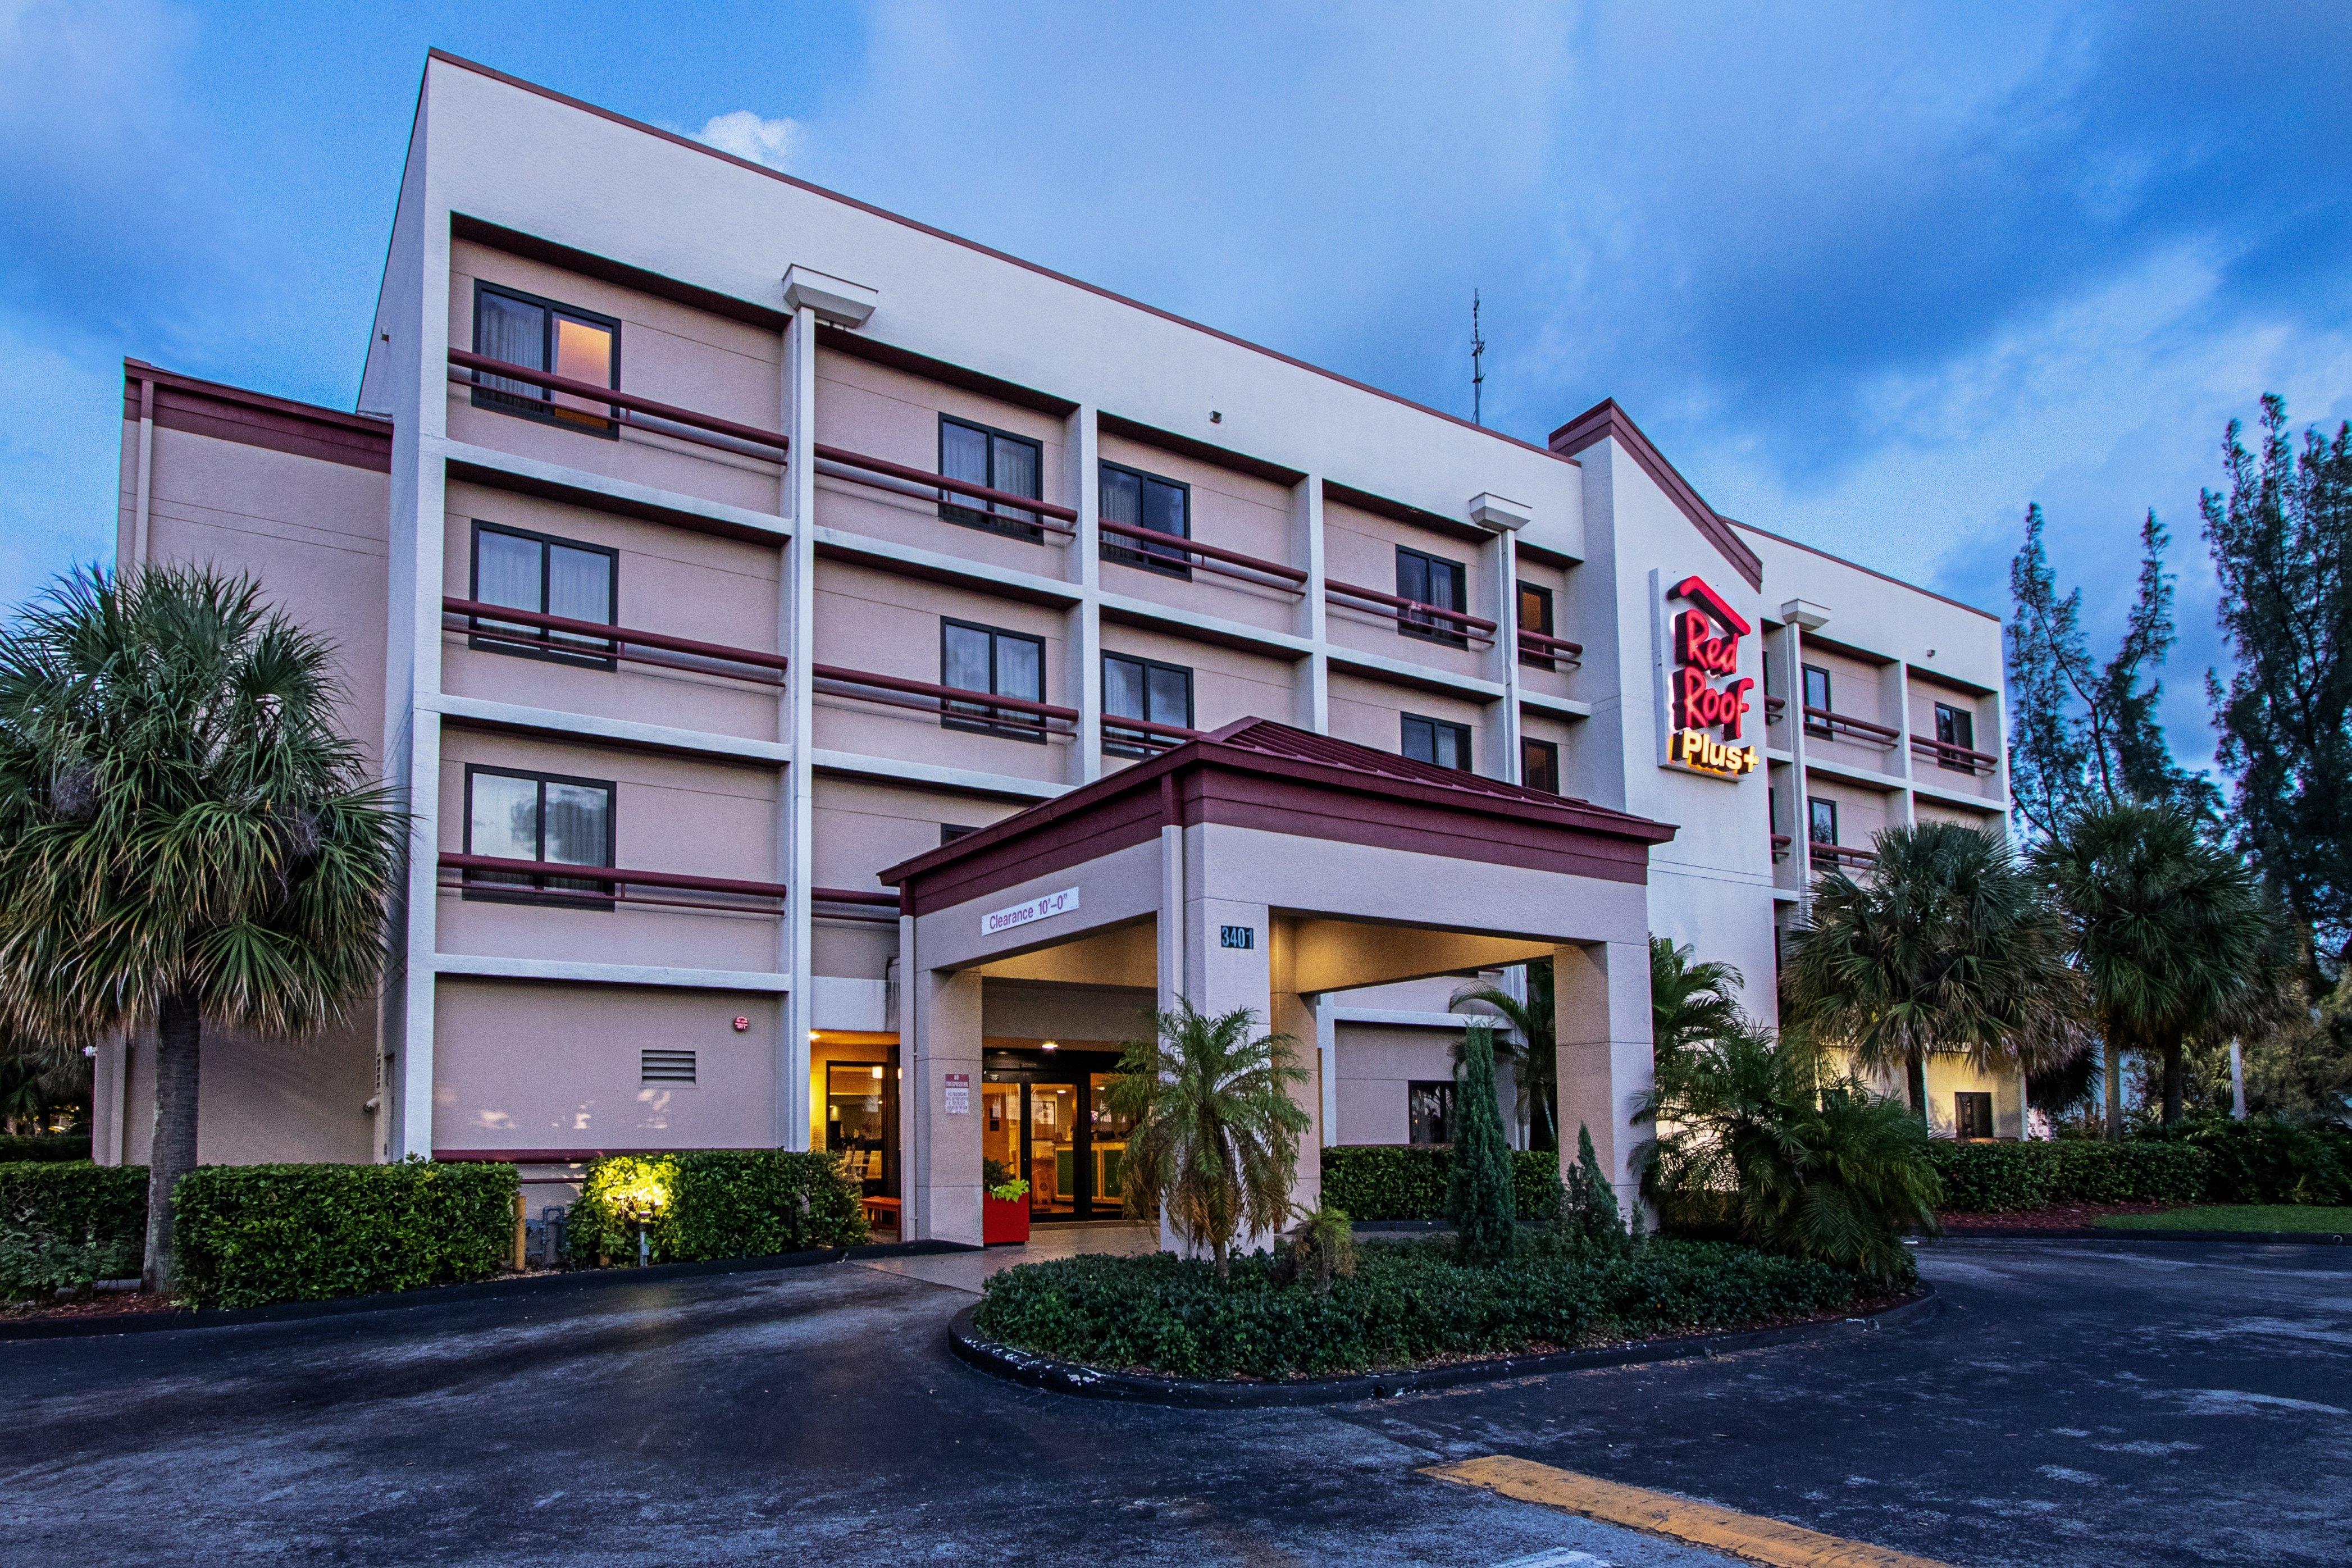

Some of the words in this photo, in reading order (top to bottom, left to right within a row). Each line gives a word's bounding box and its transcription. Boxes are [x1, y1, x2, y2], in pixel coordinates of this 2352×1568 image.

[1684, 609, 1739, 674] Red
[1684, 666, 1754, 739] Roof
[1682, 730, 1760, 773] Plus+
[990, 906, 1033, 930] Clearance
[1221, 927, 1253, 949] 3401
